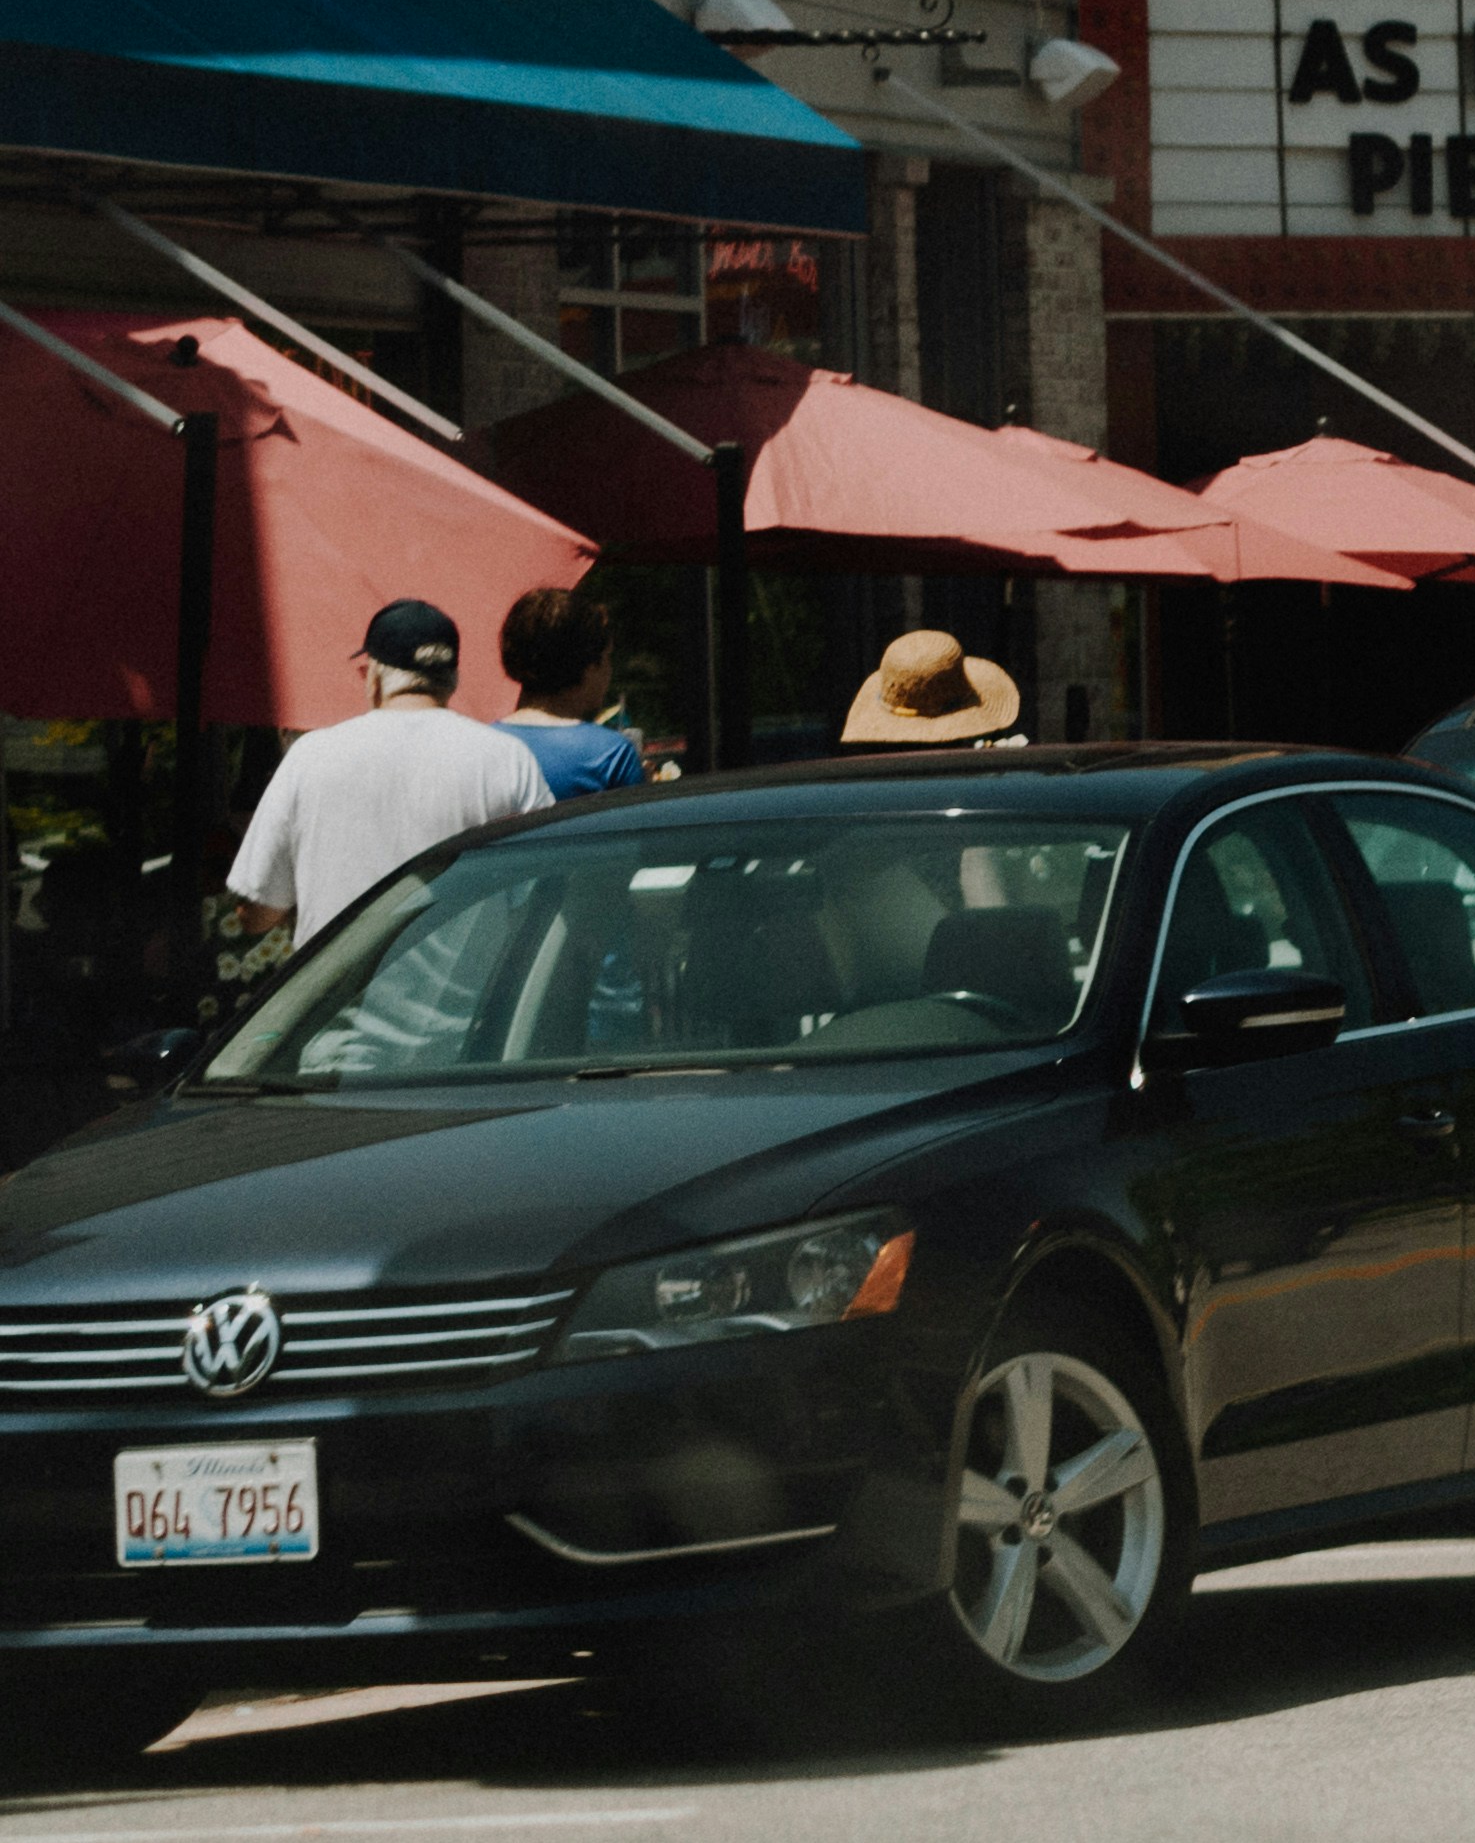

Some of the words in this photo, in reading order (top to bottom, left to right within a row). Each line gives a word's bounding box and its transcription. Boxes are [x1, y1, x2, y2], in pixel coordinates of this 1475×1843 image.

[1288, 19, 1419, 106] AS
[187, 1457, 266, 1478] Illinois
[214, 1482, 305, 1540] 7956
